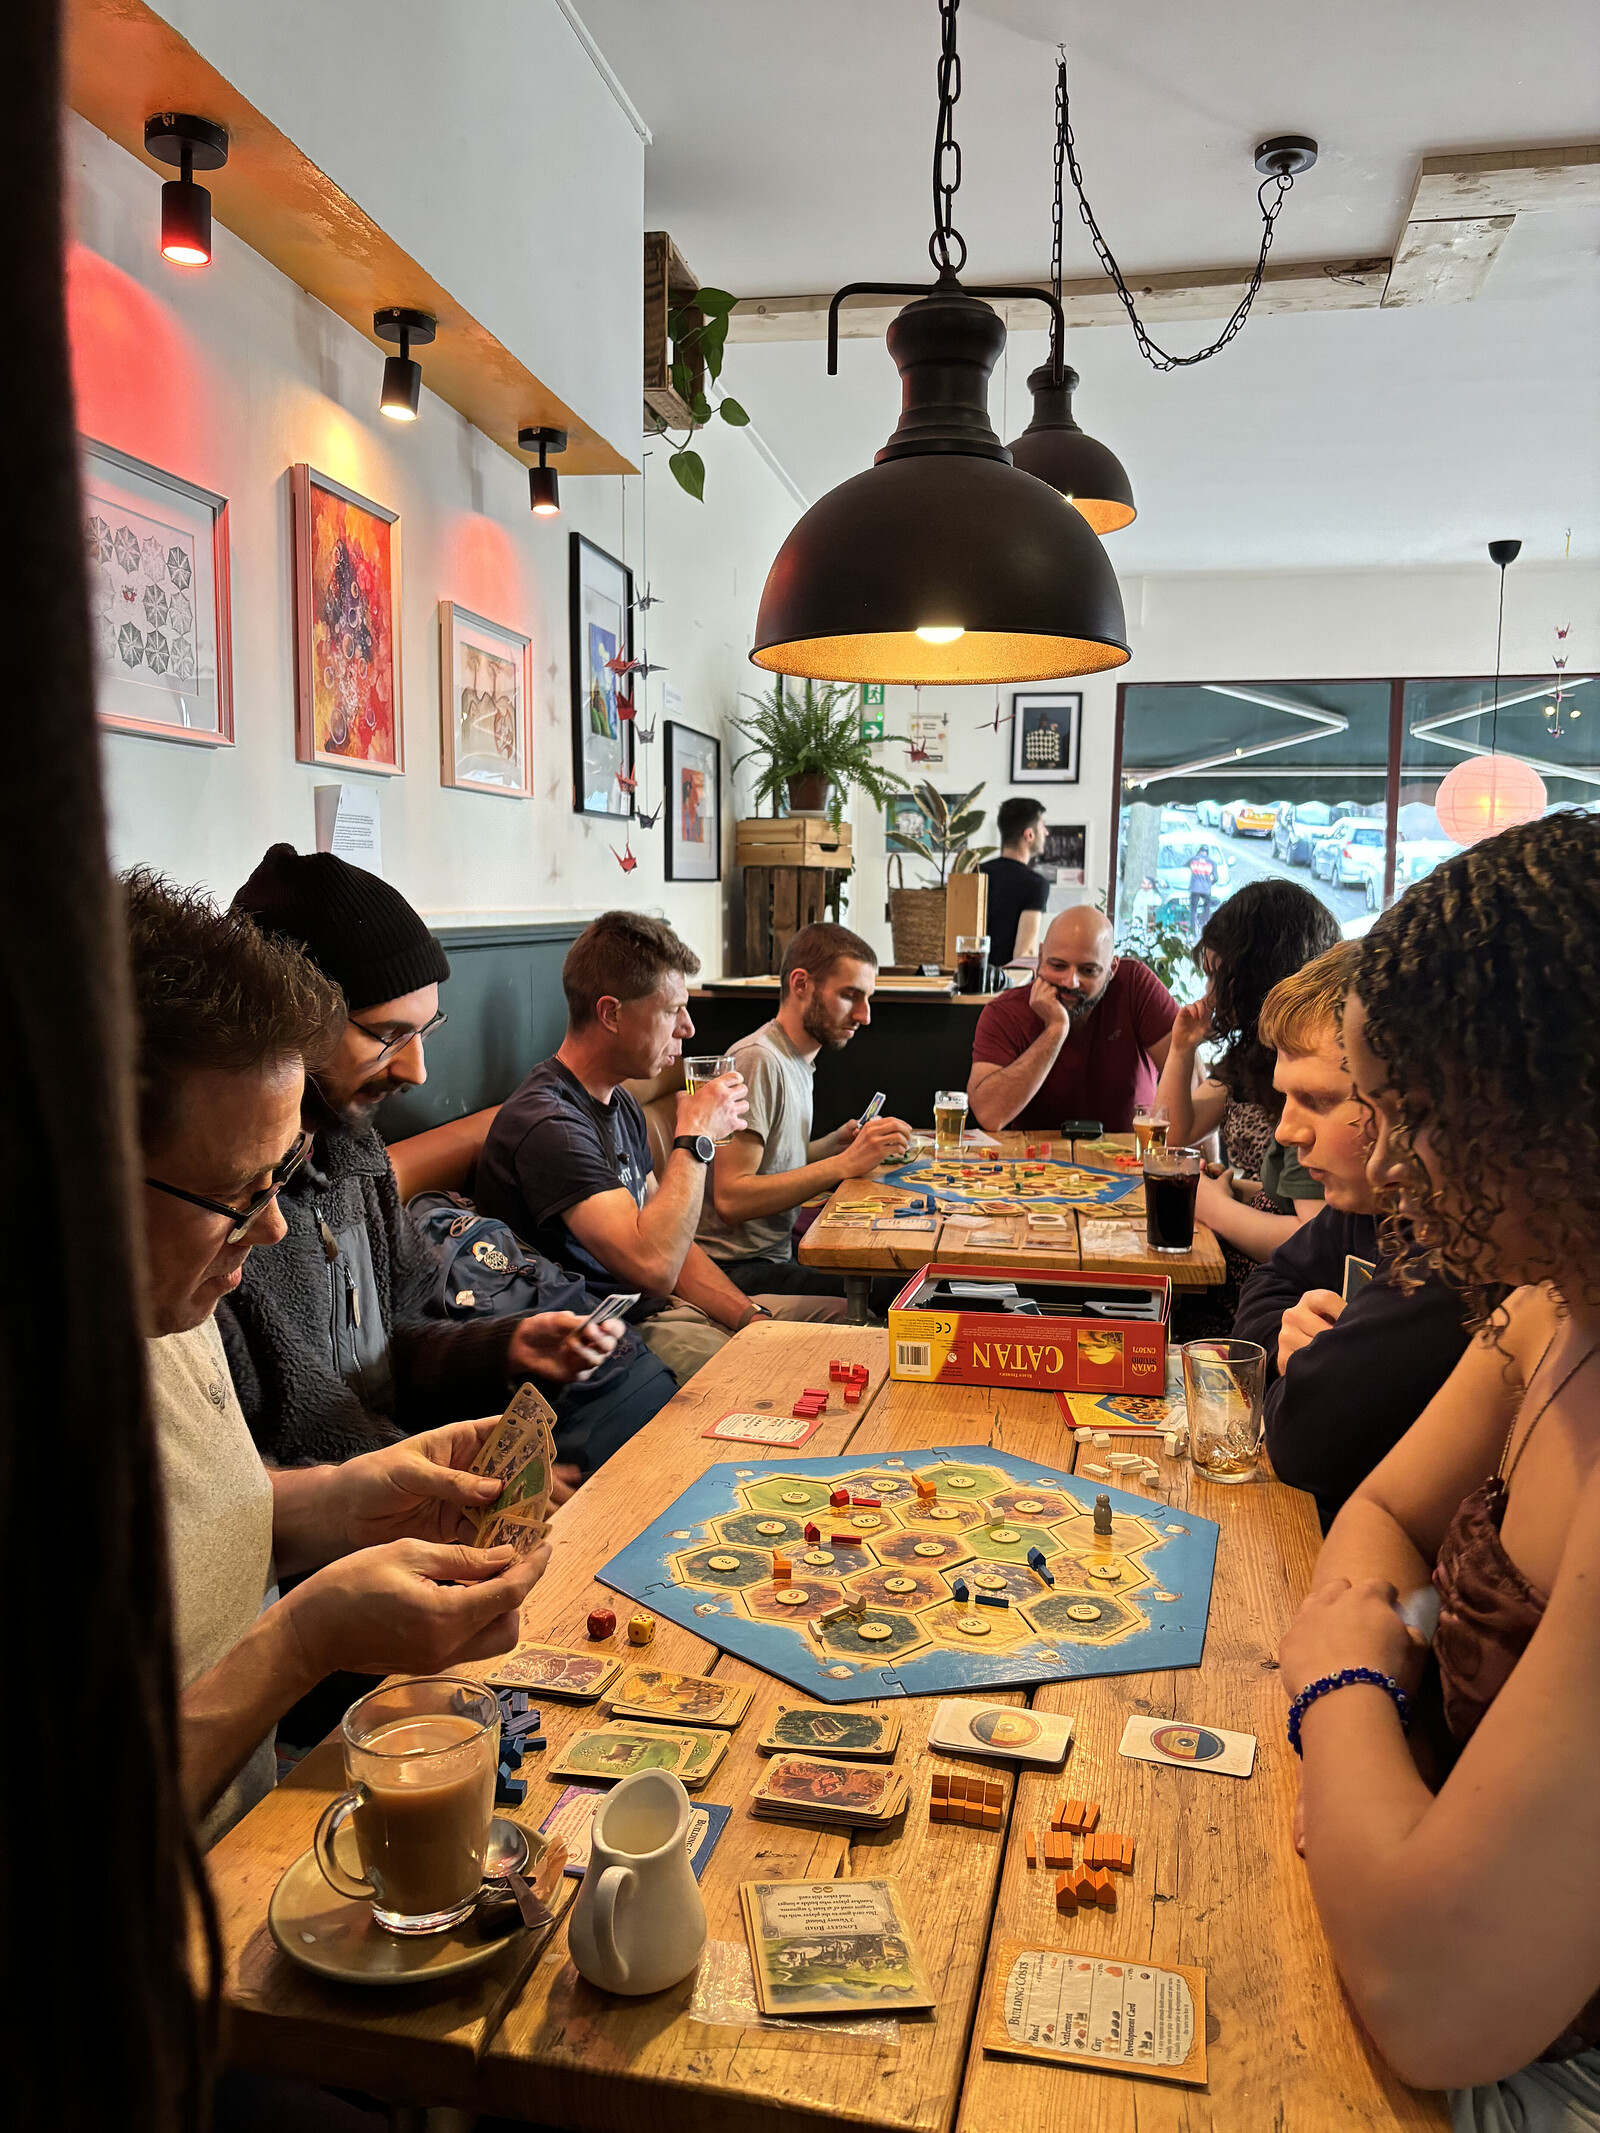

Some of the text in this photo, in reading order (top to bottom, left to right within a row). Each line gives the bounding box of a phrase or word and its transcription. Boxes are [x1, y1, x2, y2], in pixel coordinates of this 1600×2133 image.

[972, 1342, 1063, 1373] CATAN
[1132, 1346, 1156, 1354] CN3071
[1132, 1364, 1156, 1373] CATAN
[1008, 1962, 1028, 2026] BUILDING COSTS
[1029, 2024, 1040, 2041] Road
[1060, 2013, 1073, 2046] Settlement
[1124, 2003, 1137, 2057] Development Card
[1091, 2037, 1104, 2052] City
